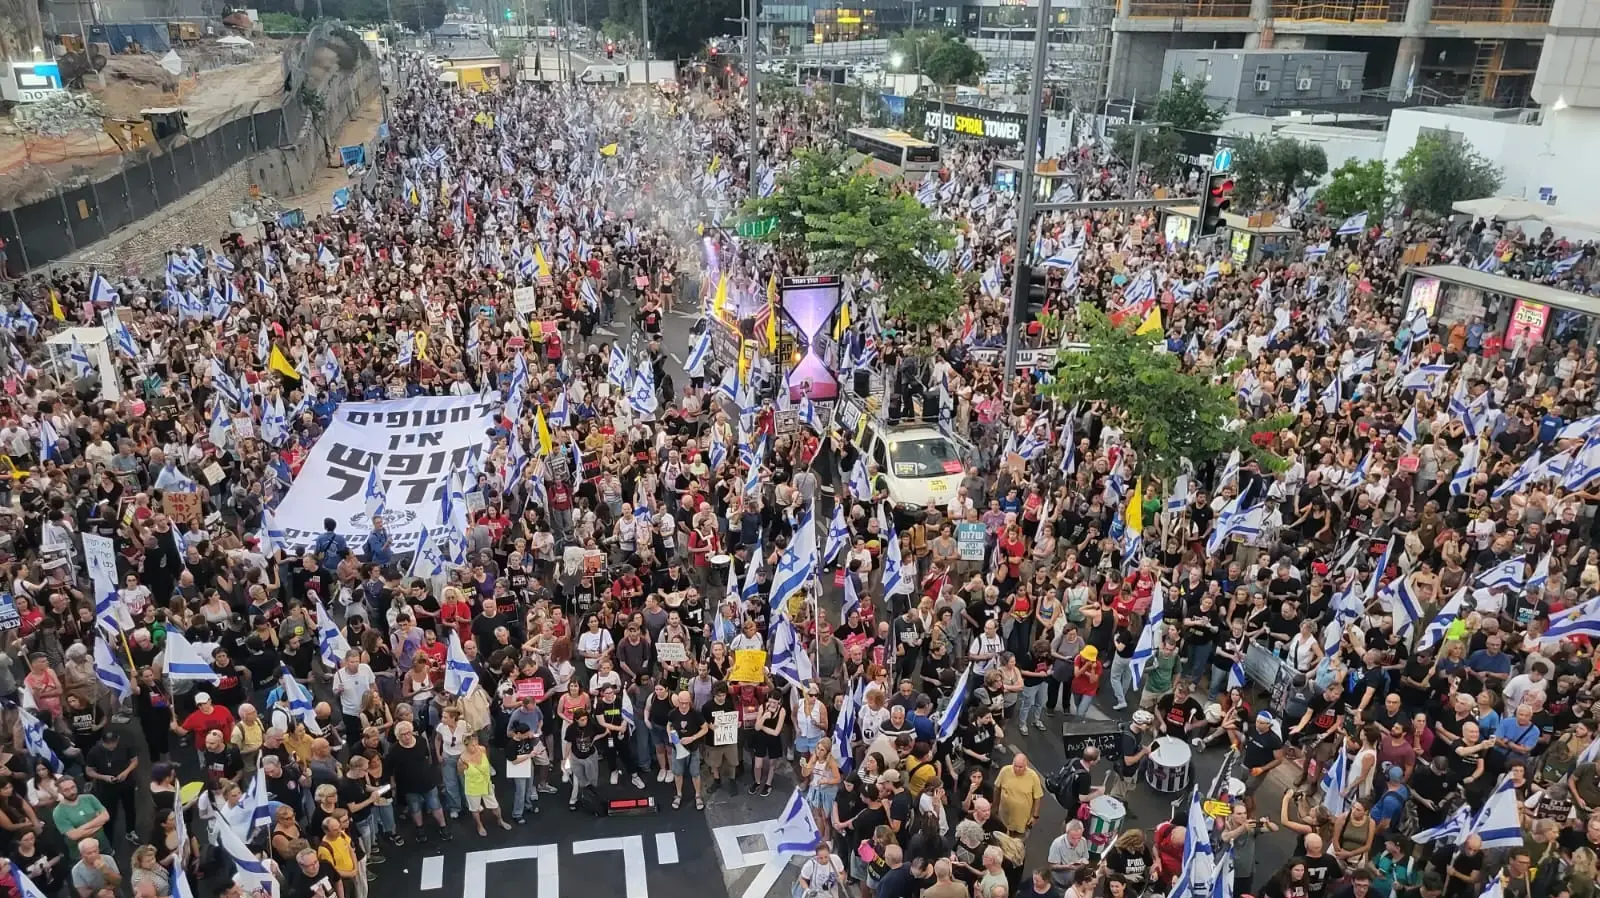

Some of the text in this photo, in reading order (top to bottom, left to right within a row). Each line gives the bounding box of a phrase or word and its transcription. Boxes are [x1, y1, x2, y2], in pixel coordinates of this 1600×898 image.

[925, 112, 956, 130] AZRELI
[955, 115, 984, 137] SPIRAL
[985, 120, 1020, 139] TOWER
[346, 402, 494, 428] לחטופים
[388, 430, 444, 450] אין
[326, 442, 483, 475] חופש
[960, 531, 984, 540] שלום
[717, 714, 738, 723] STOP
[716, 732, 734, 743] WAR
